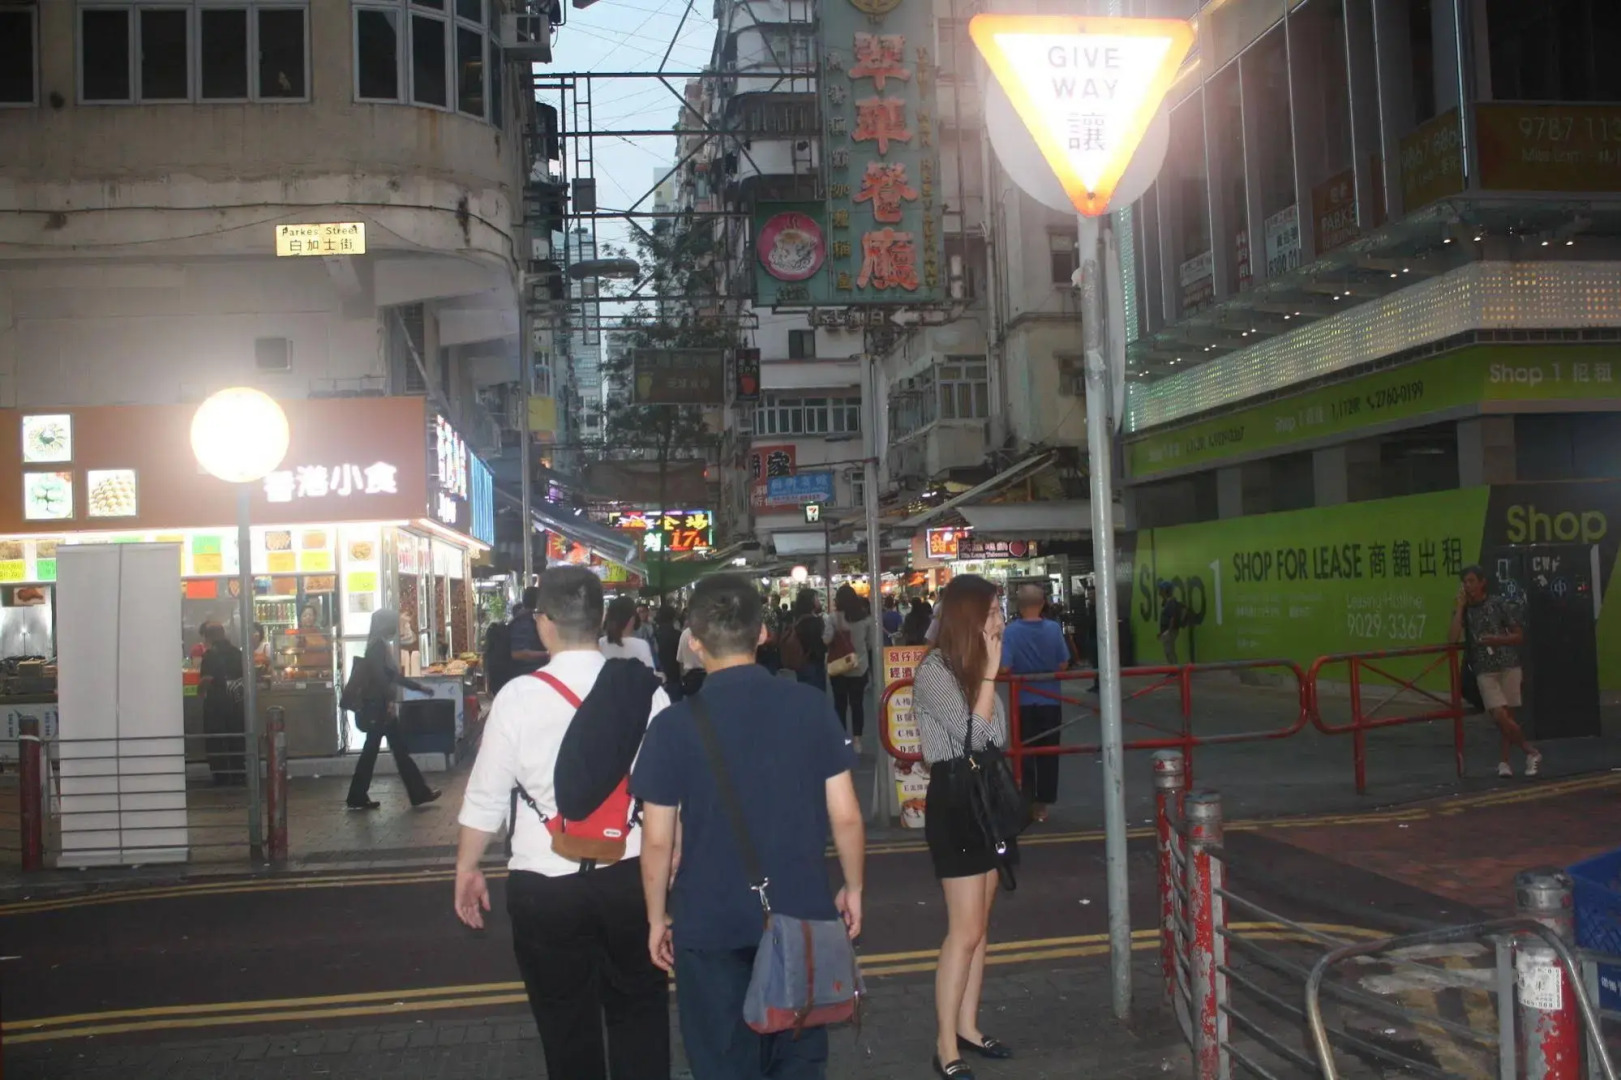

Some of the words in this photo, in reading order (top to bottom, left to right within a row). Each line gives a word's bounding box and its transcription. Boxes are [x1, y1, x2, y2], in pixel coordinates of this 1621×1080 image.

[1047, 45, 1121, 69] GIVE
[1051, 77, 1119, 99] WAY
[1066, 112, 1106, 151] 讓
[848, 32, 918, 291] 翠華餐廳
[282, 227, 319, 237] Parkes
[326, 225, 358, 235] Street
[289, 239, 353, 251] 白加士街
[1489, 362, 1543, 388] Shop
[1552, 362, 1561, 381] 1
[264, 462, 397, 502] 香港小食
[1507, 505, 1607, 544] Shop
[1233, 551, 1271, 582] SHOP
[1277, 549, 1308, 580] FOR
[1313, 543, 1362, 579] LEASE
